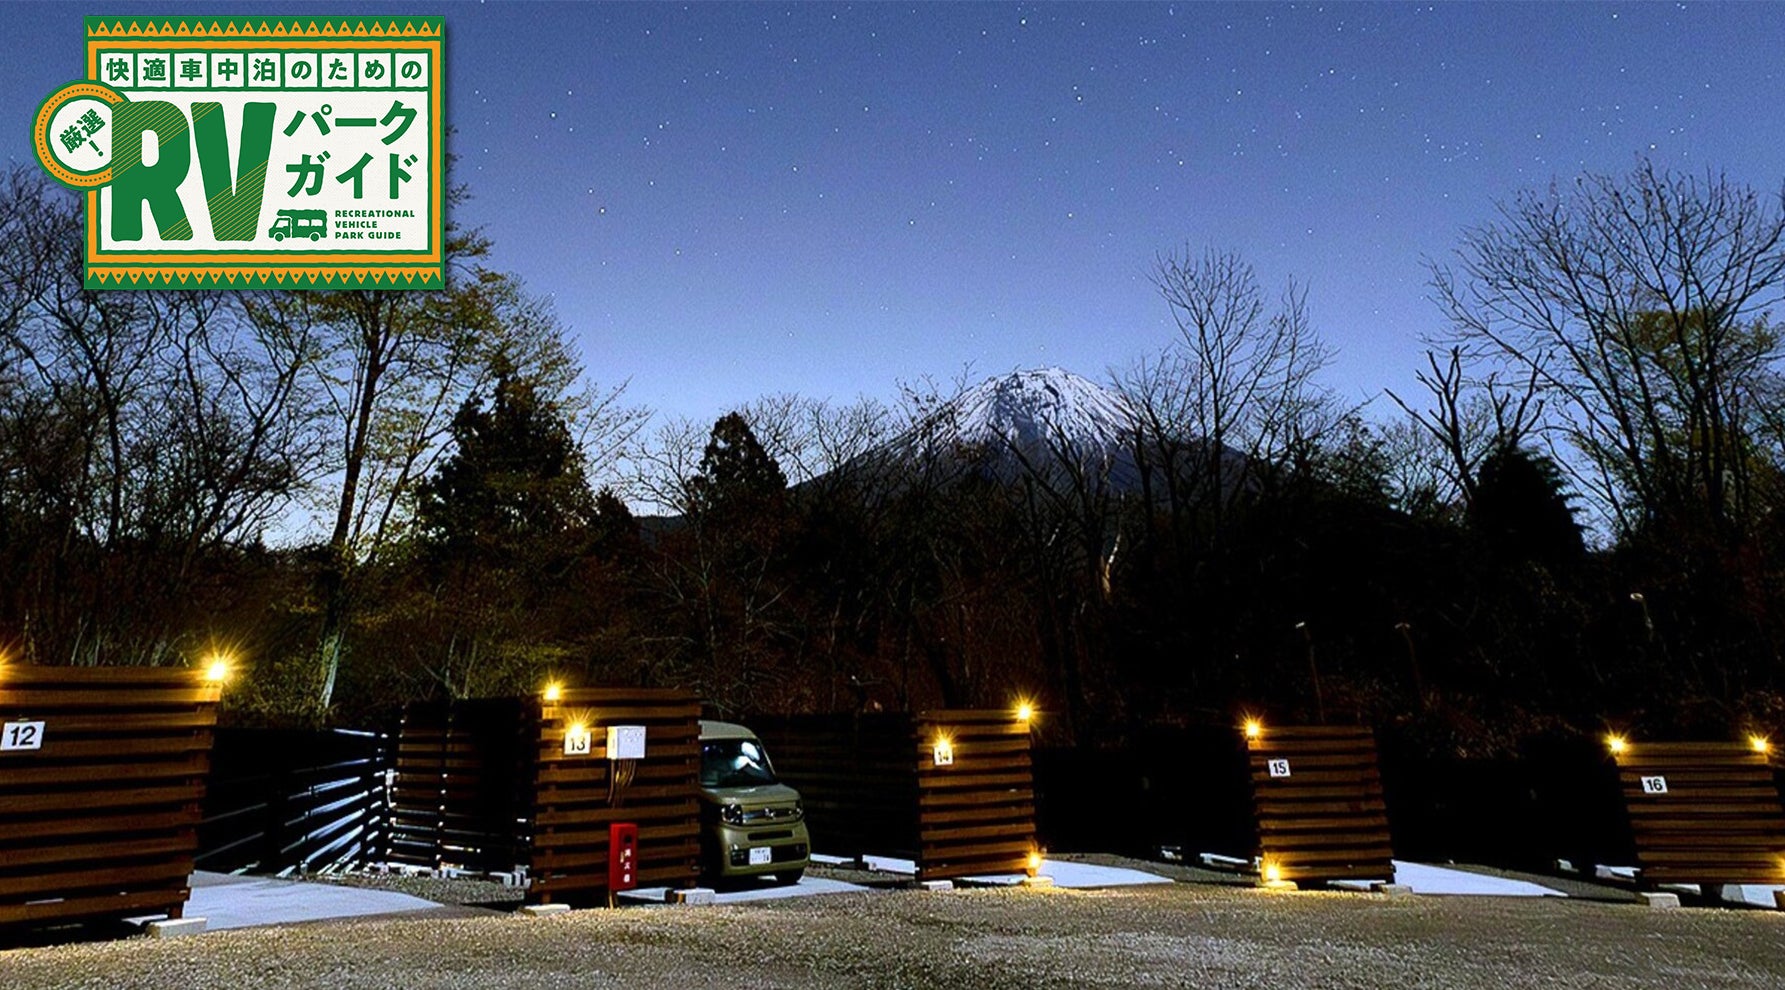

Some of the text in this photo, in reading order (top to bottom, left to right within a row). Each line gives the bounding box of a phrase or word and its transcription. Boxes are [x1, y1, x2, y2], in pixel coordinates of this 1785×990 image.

[10, 725, 37, 747] 12
[571, 735, 586, 751] 13
[1273, 761, 1287, 775] 15
[1646, 778, 1663, 791] 16
